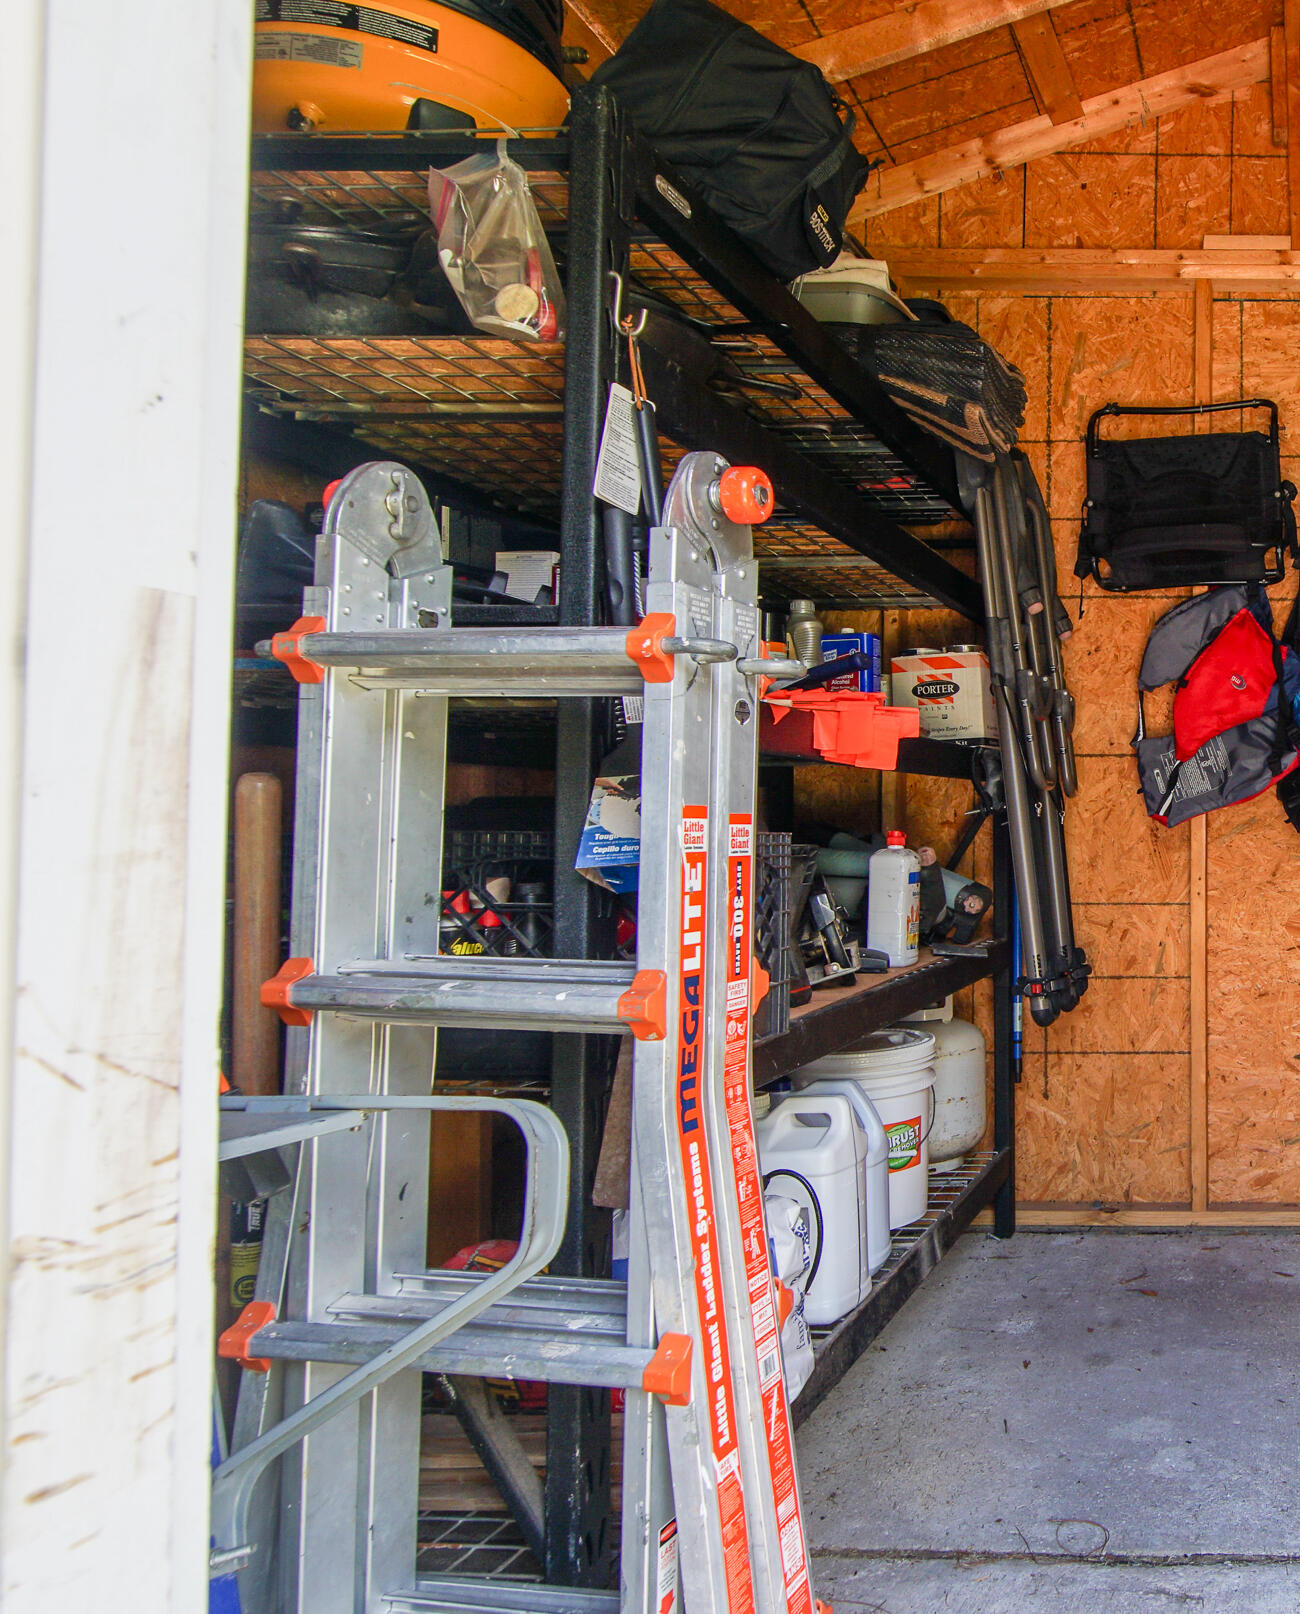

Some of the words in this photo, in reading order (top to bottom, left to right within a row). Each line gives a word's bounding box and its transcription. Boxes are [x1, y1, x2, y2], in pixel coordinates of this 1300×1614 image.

[809, 211, 835, 252] BOSTITCH
[917, 684, 955, 695] PORTER
[683, 821, 705, 833] Little
[683, 833, 704, 845] Giant
[730, 827, 750, 838] Little
[730, 838, 750, 849] Giant
[592, 845, 620, 854] Cepillo
[621, 844, 640, 852] duro
[733, 896, 744, 938] 300
[680, 862, 702, 1134] MEGALITE
[689, 1142, 711, 1238] Systems
[700, 1241, 717, 1321] Ladder
[708, 1322, 724, 1384] Giant
[715, 1385, 731, 1449] Little
